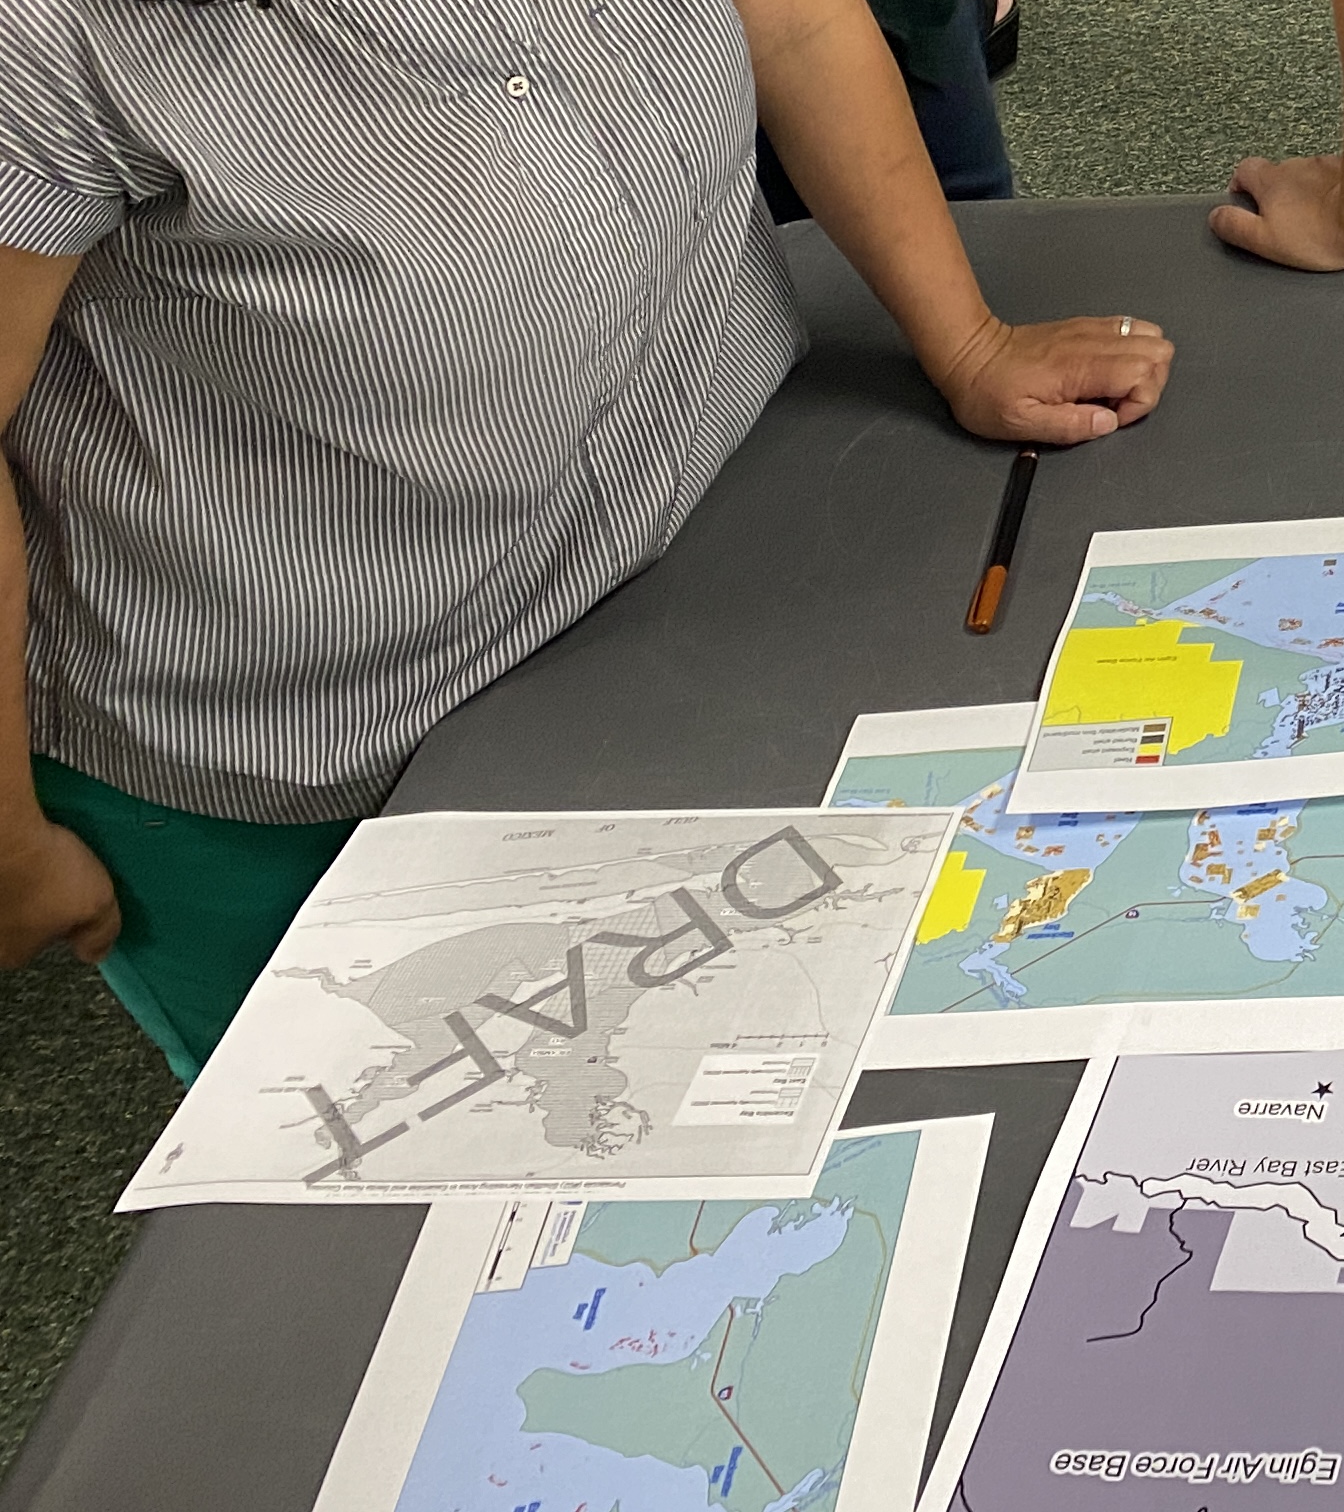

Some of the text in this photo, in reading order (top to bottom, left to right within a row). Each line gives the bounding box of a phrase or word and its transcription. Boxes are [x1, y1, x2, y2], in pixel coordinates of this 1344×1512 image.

[502, 830, 555, 841] MEXICO
[595, 824, 616, 833] OF
[302, 825, 844, 1187] DRAFT
[1239, 1098, 1324, 1119] Navarre
[1183, 1159, 1255, 1179] River
[1260, 1157, 1297, 1177] Bay
[1056, 1453, 1336, 1481] Eglin Air Force Base
